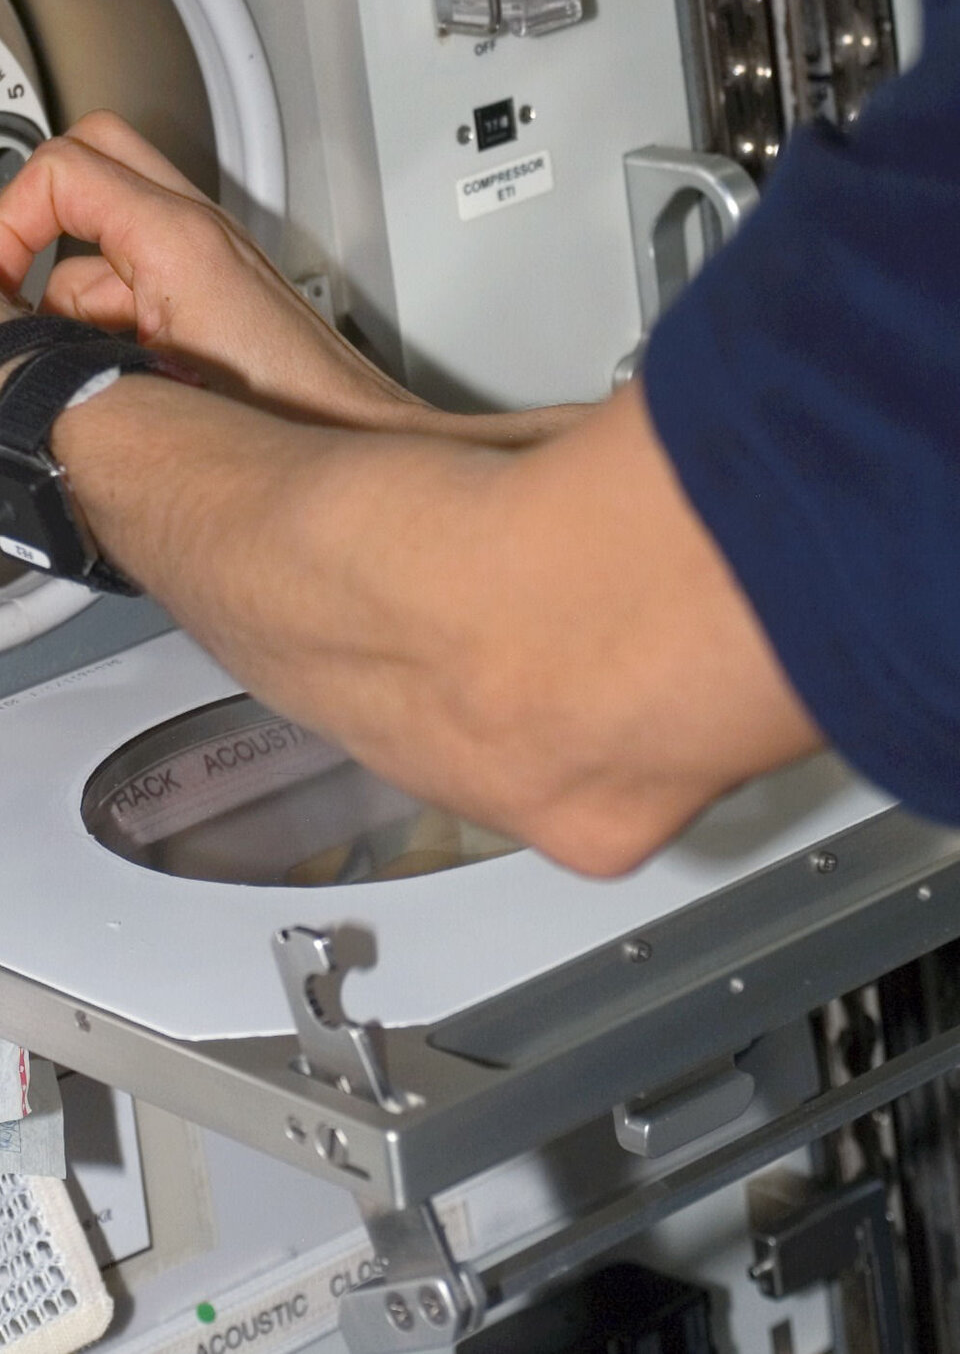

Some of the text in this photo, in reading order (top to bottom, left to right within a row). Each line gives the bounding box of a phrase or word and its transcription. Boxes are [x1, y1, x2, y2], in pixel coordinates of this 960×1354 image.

[7, 84, 25, 100] 5
[462, 157, 544, 197] COMPRESSOR
[112, 768, 182, 815] RACK
